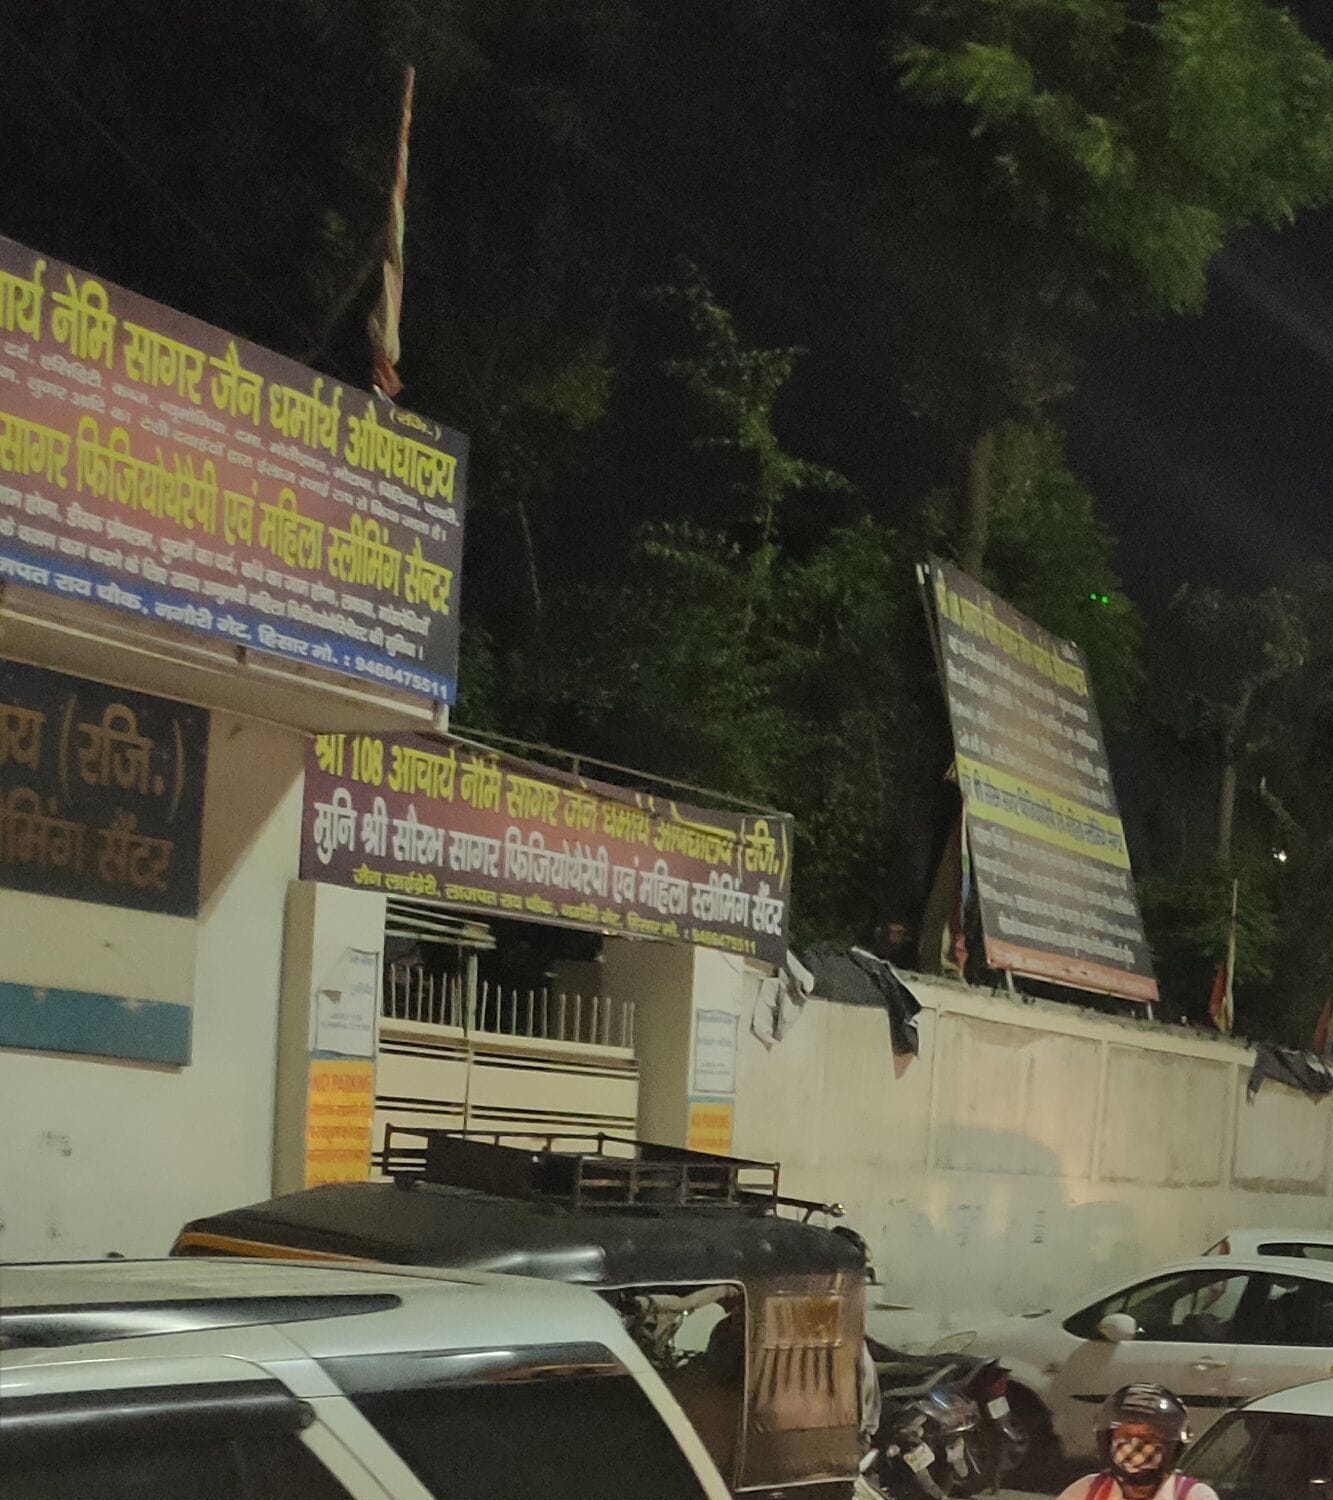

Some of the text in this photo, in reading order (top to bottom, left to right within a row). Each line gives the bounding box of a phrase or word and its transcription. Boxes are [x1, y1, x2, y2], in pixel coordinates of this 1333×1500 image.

[52, 273, 117, 369] नेमि
[124, 321, 206, 404] सागर
[210, 340, 263, 426] जैन
[270, 377, 343, 456] धर्मार्थ
[345, 400, 457, 503] औषधालय
[223, 479, 258, 546] एवं
[259, 487, 325, 569] महिला
[328, 512, 401, 597] स्लीमिंग
[258, 624, 310, 655] हिसार
[352, 736, 383, 786] 108
[388, 744, 457, 802] आचार्य
[507, 775, 560, 827] सागर
[313, 787, 357, 865] मुनि
[361, 796, 389, 857] श्री
[392, 803, 445, 866] सौरभ
[449, 830, 501, 878] सागर
[612, 855, 640, 903] एवं
[639, 858, 690, 915] महिला
[692, 870, 750, 927] स्लीमिंग
